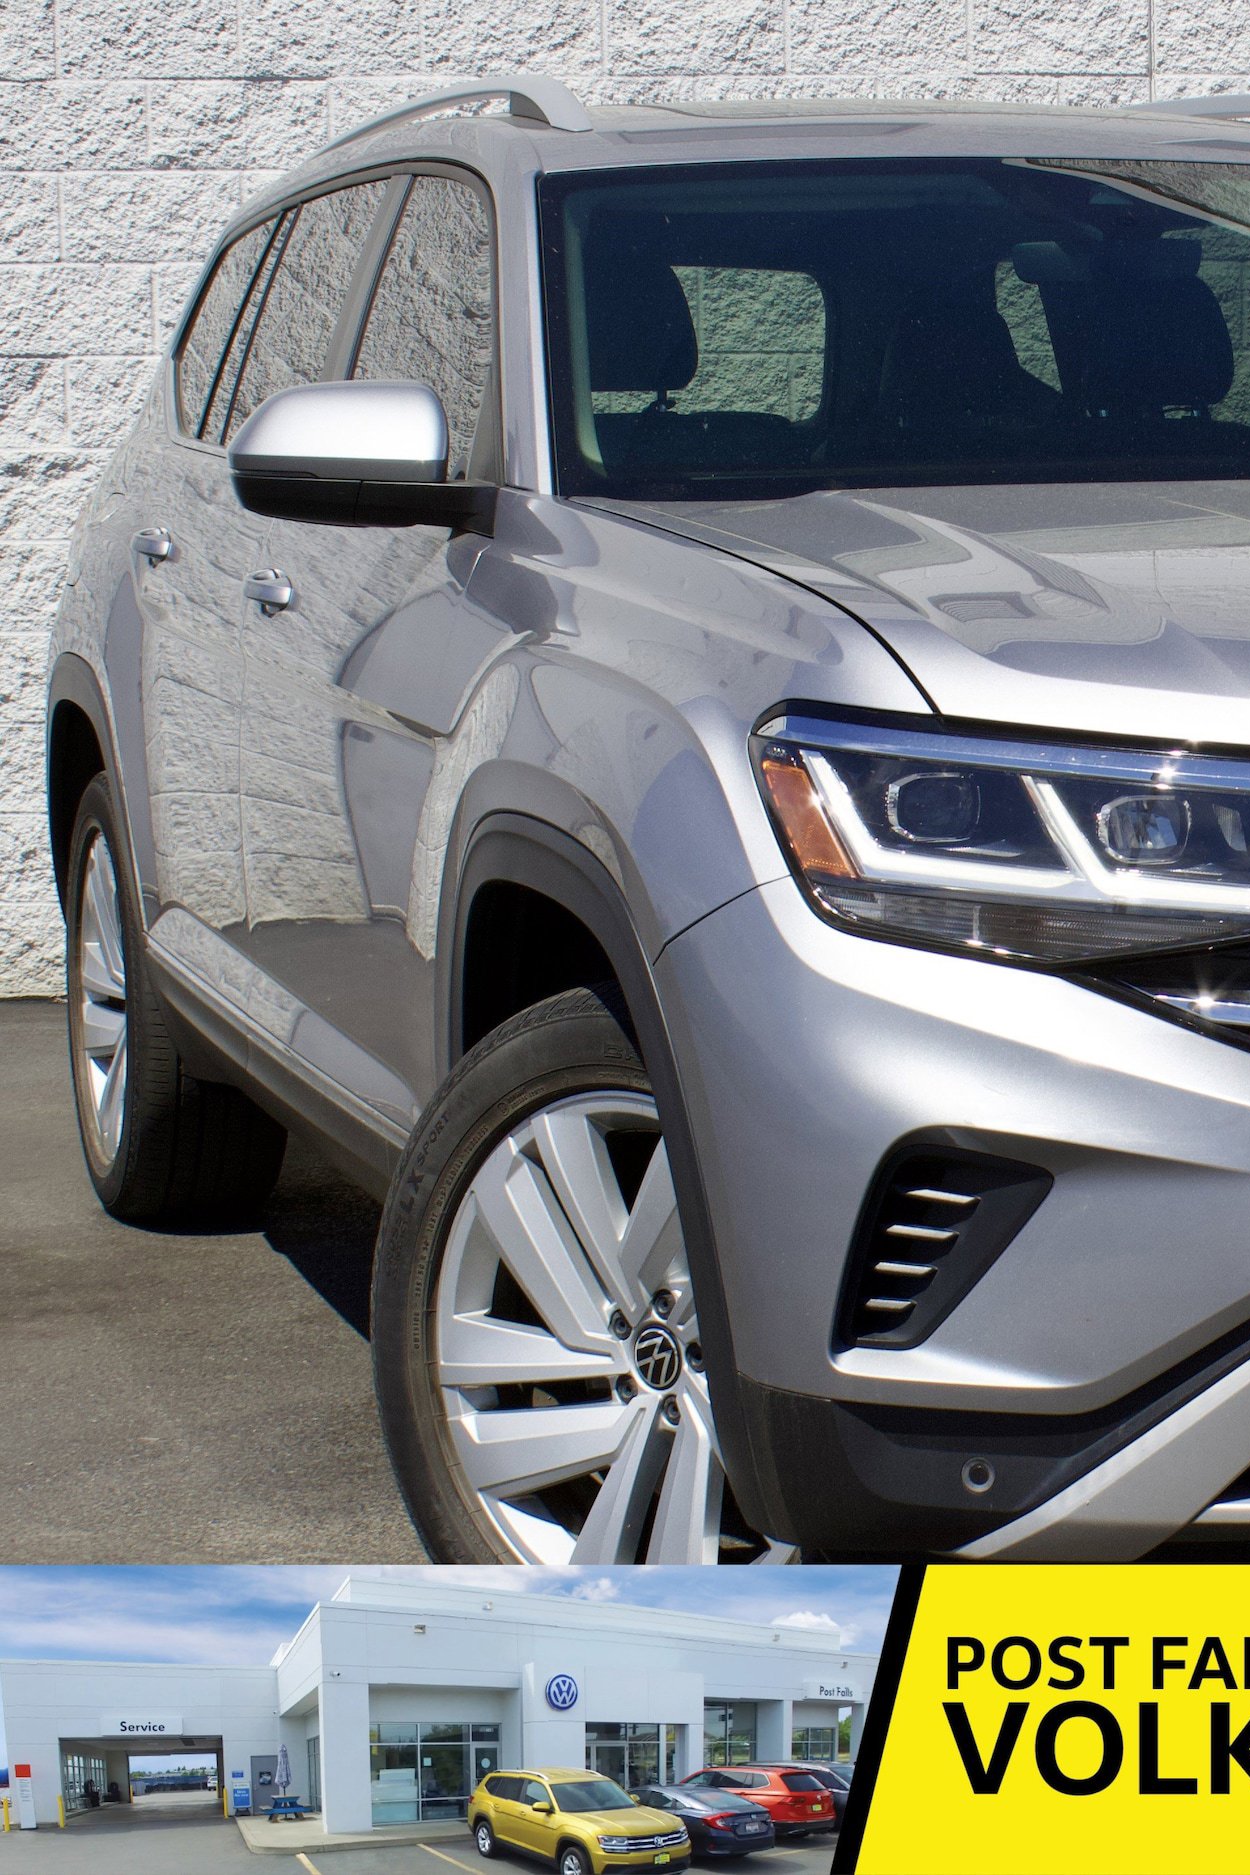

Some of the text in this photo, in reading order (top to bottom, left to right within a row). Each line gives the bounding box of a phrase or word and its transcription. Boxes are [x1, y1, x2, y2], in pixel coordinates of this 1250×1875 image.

[416, 1110, 450, 1167] SPORT
[819, 1685, 853, 1697] Post Falls
[120, 1721, 165, 1731] Service
